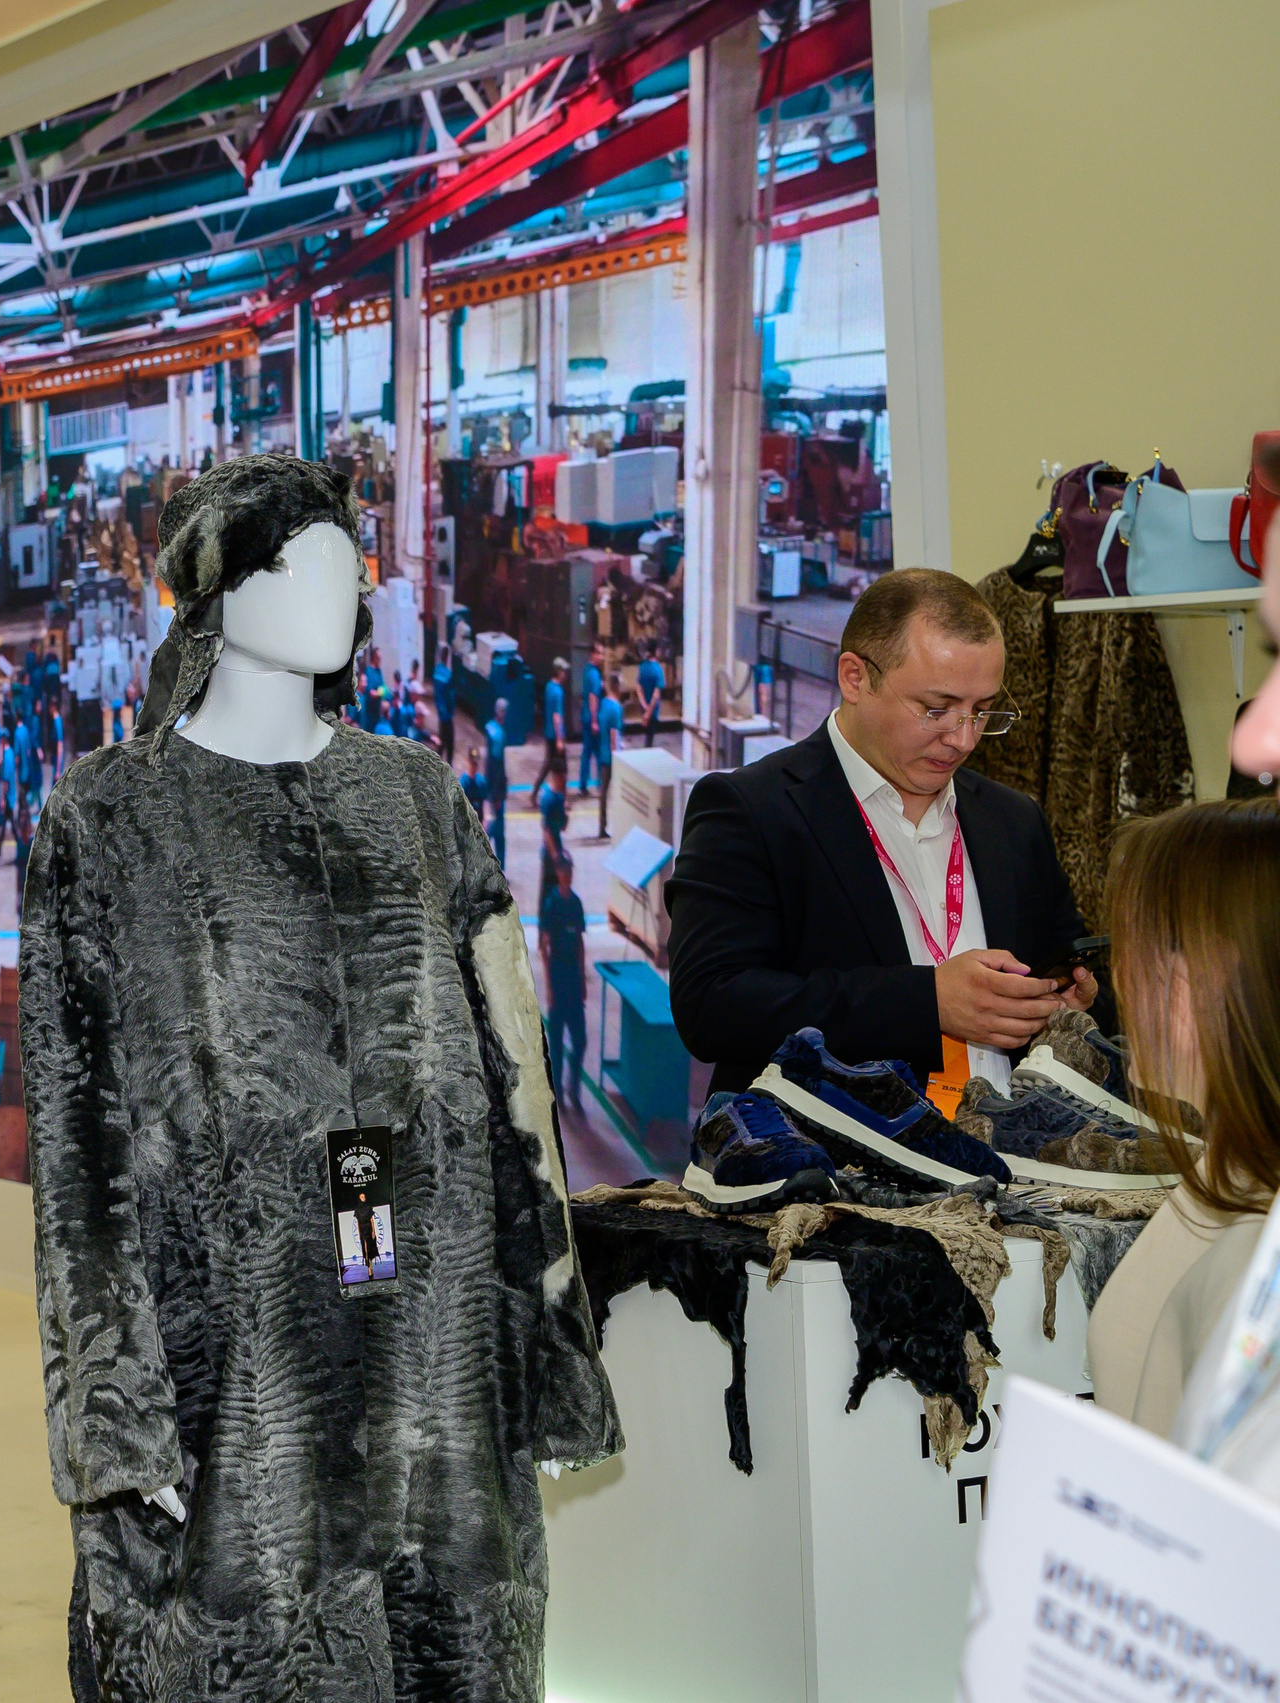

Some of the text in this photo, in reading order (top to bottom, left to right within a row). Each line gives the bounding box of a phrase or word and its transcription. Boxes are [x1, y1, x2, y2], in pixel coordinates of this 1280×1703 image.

[337, 1146, 380, 1162] SALAY ZUHRA
[342, 1174, 378, 1184] KARAKUL
